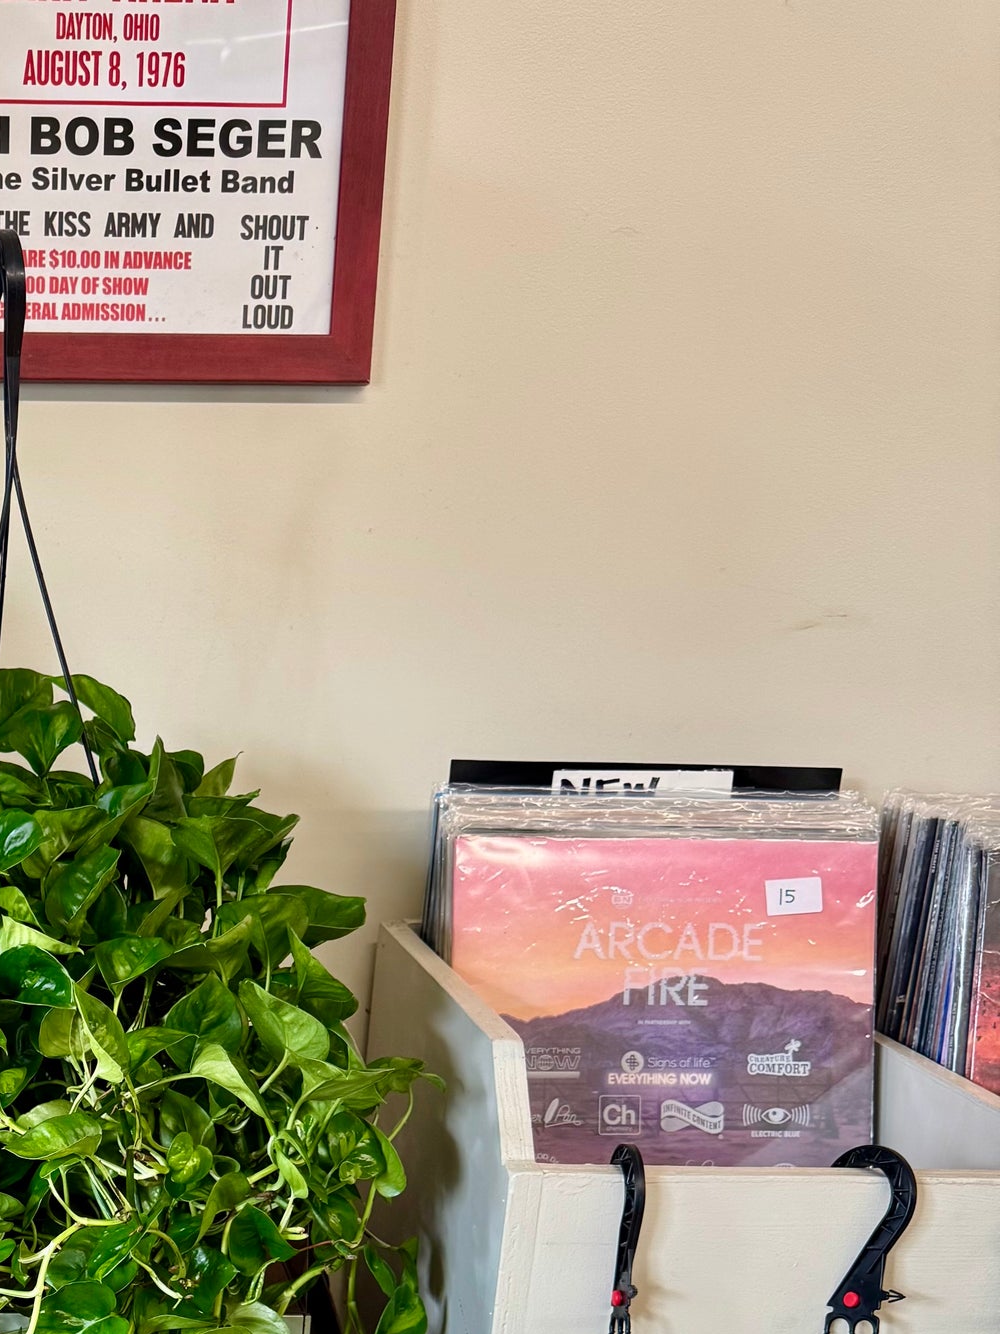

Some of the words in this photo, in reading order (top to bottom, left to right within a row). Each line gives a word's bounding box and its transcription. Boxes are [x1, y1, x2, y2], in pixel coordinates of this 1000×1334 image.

[56, 12, 118, 43] DAYTON,
[123, 13, 160, 42] OHIO
[22, 50, 102, 87] AUGUST
[108, 51, 127, 91] 8,
[136, 51, 186, 88] 1976
[30, 116, 135, 157] BOB
[152, 117, 323, 159] SEGER
[31, 166, 116, 192] Silver
[125, 168, 211, 193] Bullet
[220, 169, 295, 194] Band
[44, 211, 91, 238] KISS
[103, 212, 162, 238] ARMY
[173, 213, 215, 239] AND
[239, 214, 310, 241] SHOUT
[49, 248, 101, 270] $10.00
[104, 250, 120, 270] IN
[122, 251, 192, 270] ADVANCE
[263, 245, 284, 271] IT
[49, 276, 78, 295] DAY
[81, 276, 100, 295] OF
[102, 277, 149, 296] SHOW
[250, 274, 292, 300] OUT
[241, 304, 294, 330] LOUD
[778, 887, 796, 906] 15
[573, 921, 764, 962] ARCADE
[621, 966, 709, 1007] FIRE
[525, 1047, 581, 1055] VERYTHING
[648, 1057, 676, 1070] Signs
[679, 1056, 692, 1069] of
[749, 1055, 791, 1063] CREATURE
[607, 1072, 678, 1086] EVERYTHING
[679, 1073, 713, 1086] NOW
[749, 1063, 809, 1075] COMFORT
[602, 1103, 636, 1126] Ch
[662, 1103, 691, 1120] INFINITE
[691, 1113, 722, 1130] CONTENT
[751, 1130, 783, 1138] ELECTRIC
[784, 1130, 801, 1138] BLUE
